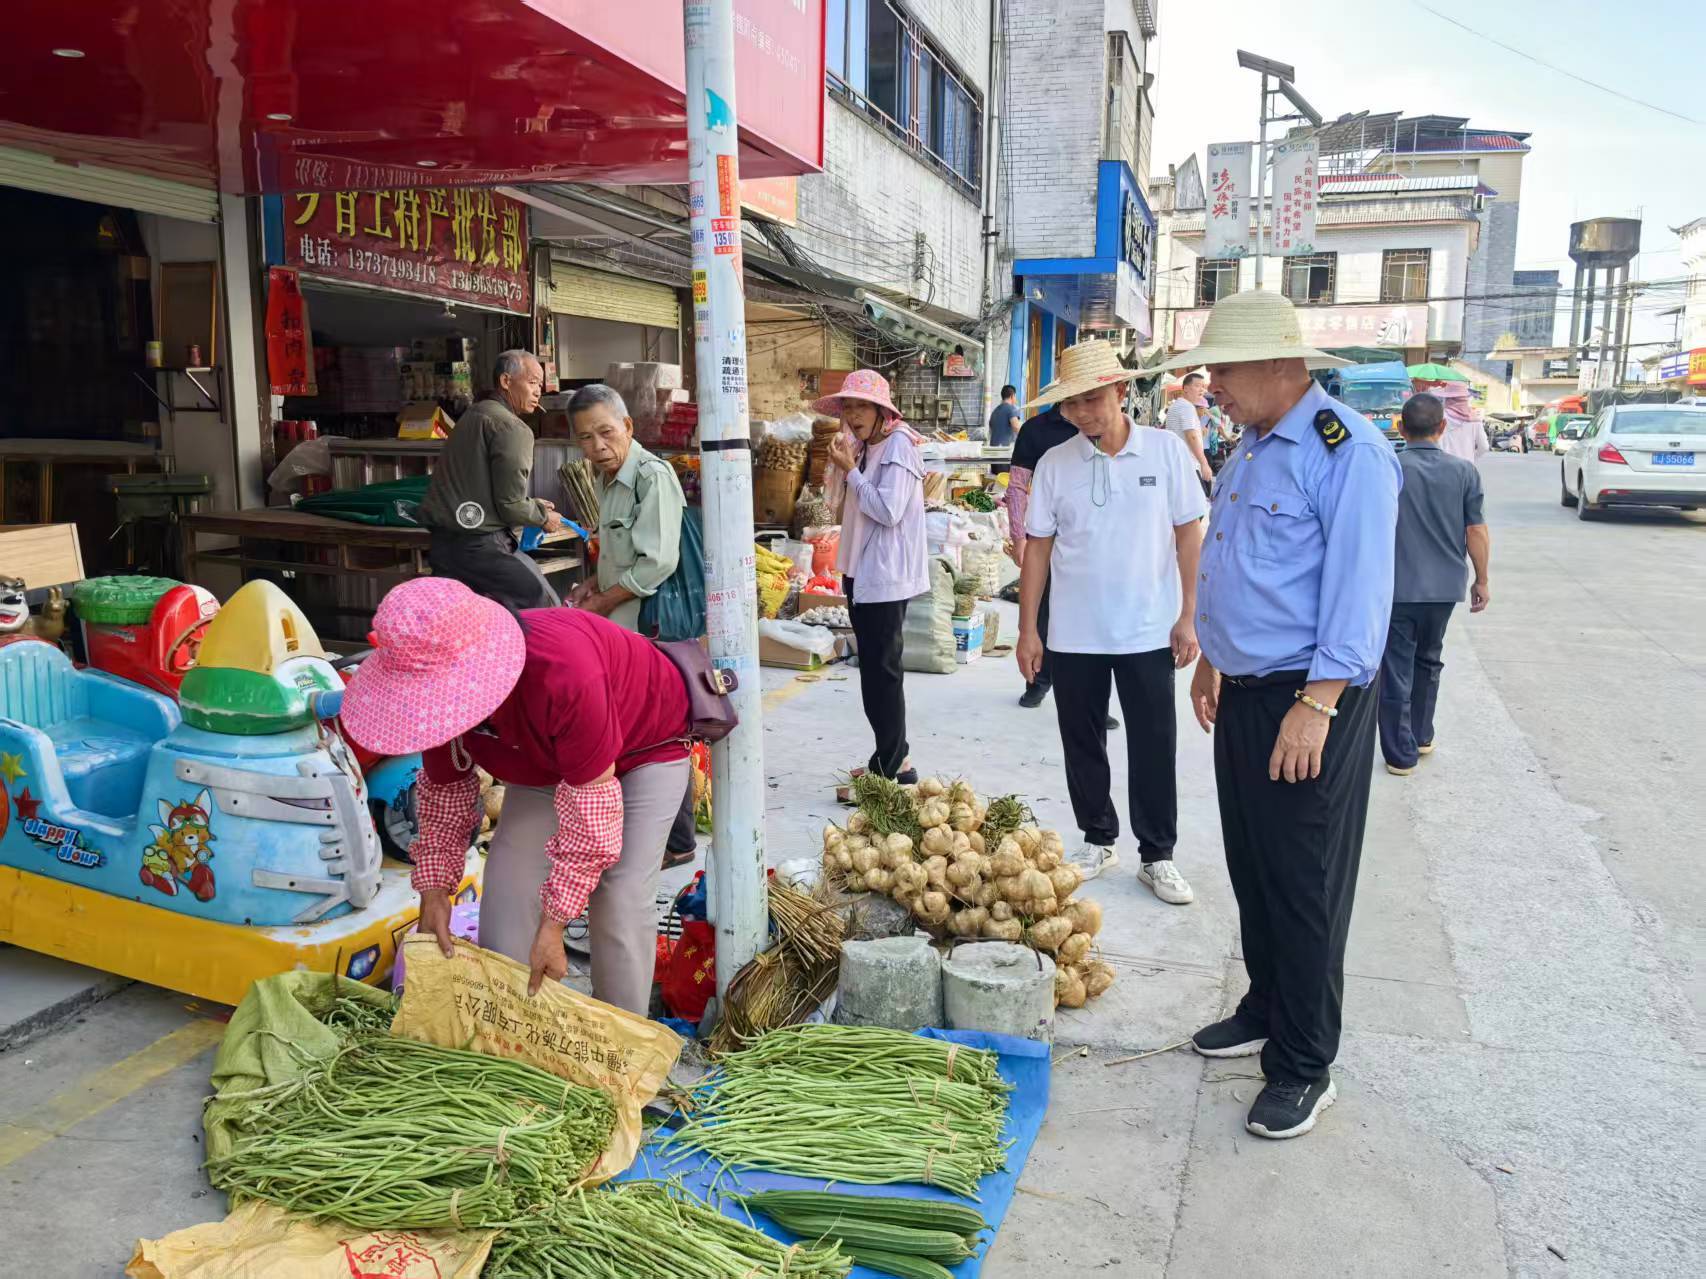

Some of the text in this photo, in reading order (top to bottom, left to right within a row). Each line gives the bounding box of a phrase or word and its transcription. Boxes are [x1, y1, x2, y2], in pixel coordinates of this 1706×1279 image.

[1212, 167, 1235, 220] 乡村振兴
[1293, 175, 1303, 232] 民族有希望
[1304, 155, 1313, 212] 人民有信仰
[1282, 192, 1292, 249] 国家有力量
[300, 233, 340, 268] 电话：
[348, 247, 436, 285] 13737493418
[1372, 412, 1392, 420] JAC
[24, 818, 78, 845] Happy
[57, 844, 100, 867] Hour
